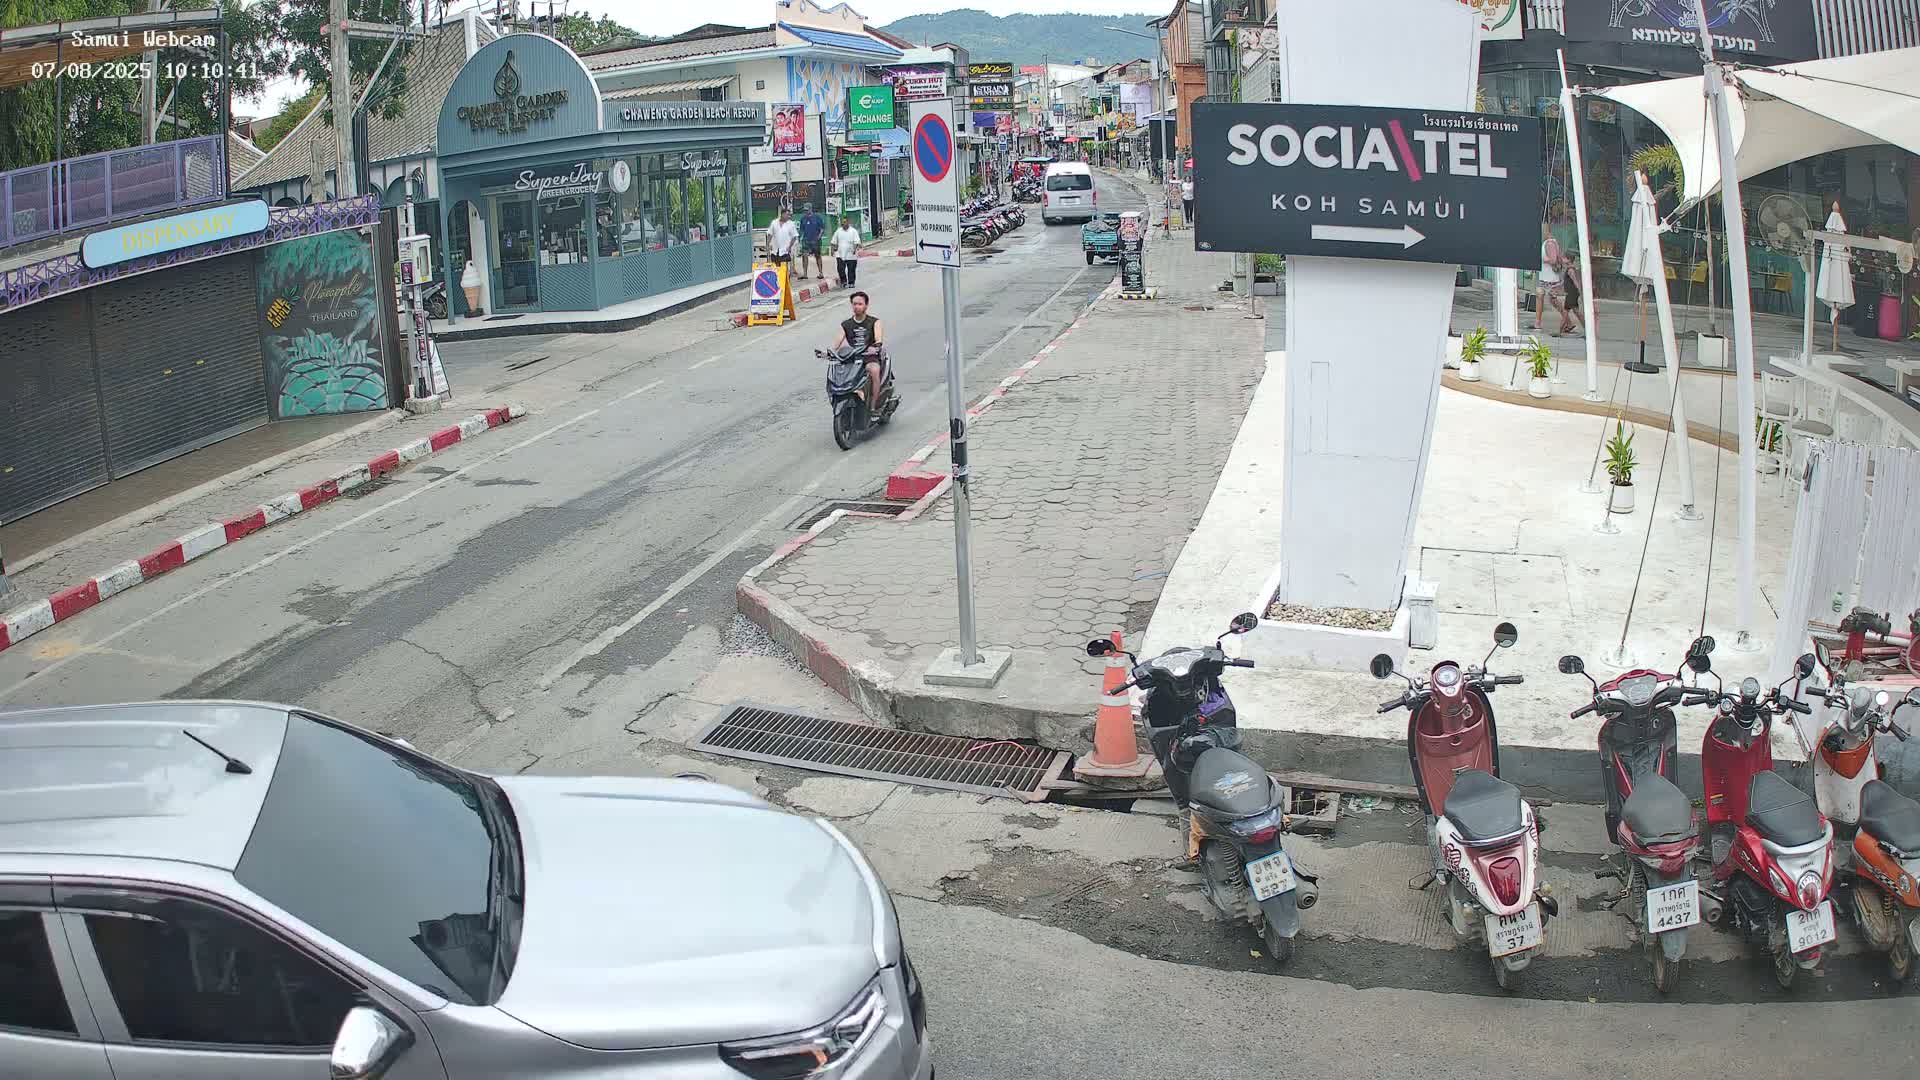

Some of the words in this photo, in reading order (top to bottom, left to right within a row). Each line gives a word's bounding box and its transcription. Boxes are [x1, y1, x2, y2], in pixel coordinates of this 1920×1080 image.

[516, 89, 569, 109] GARDEN
[624, 107, 668, 120] CHAWENG
[670, 106, 703, 120] GARDEN
[706, 106, 731, 119] BEACH
[733, 106, 760, 118] RESORT
[851, 113, 892, 124] EXCHANGE
[1271, 194, 1337, 212] KOH
[1358, 196, 1465, 220] SAMUI
[121, 211, 236, 251] DISPENSARY
[920, 223, 928, 231] NO
[929, 224, 952, 232] PARKING
[311, 310, 358, 322] THAILAND
[1657, 912, 1691, 928] 4437
[1507, 935, 1524, 950] 37
[1798, 928, 1828, 948] 9012
